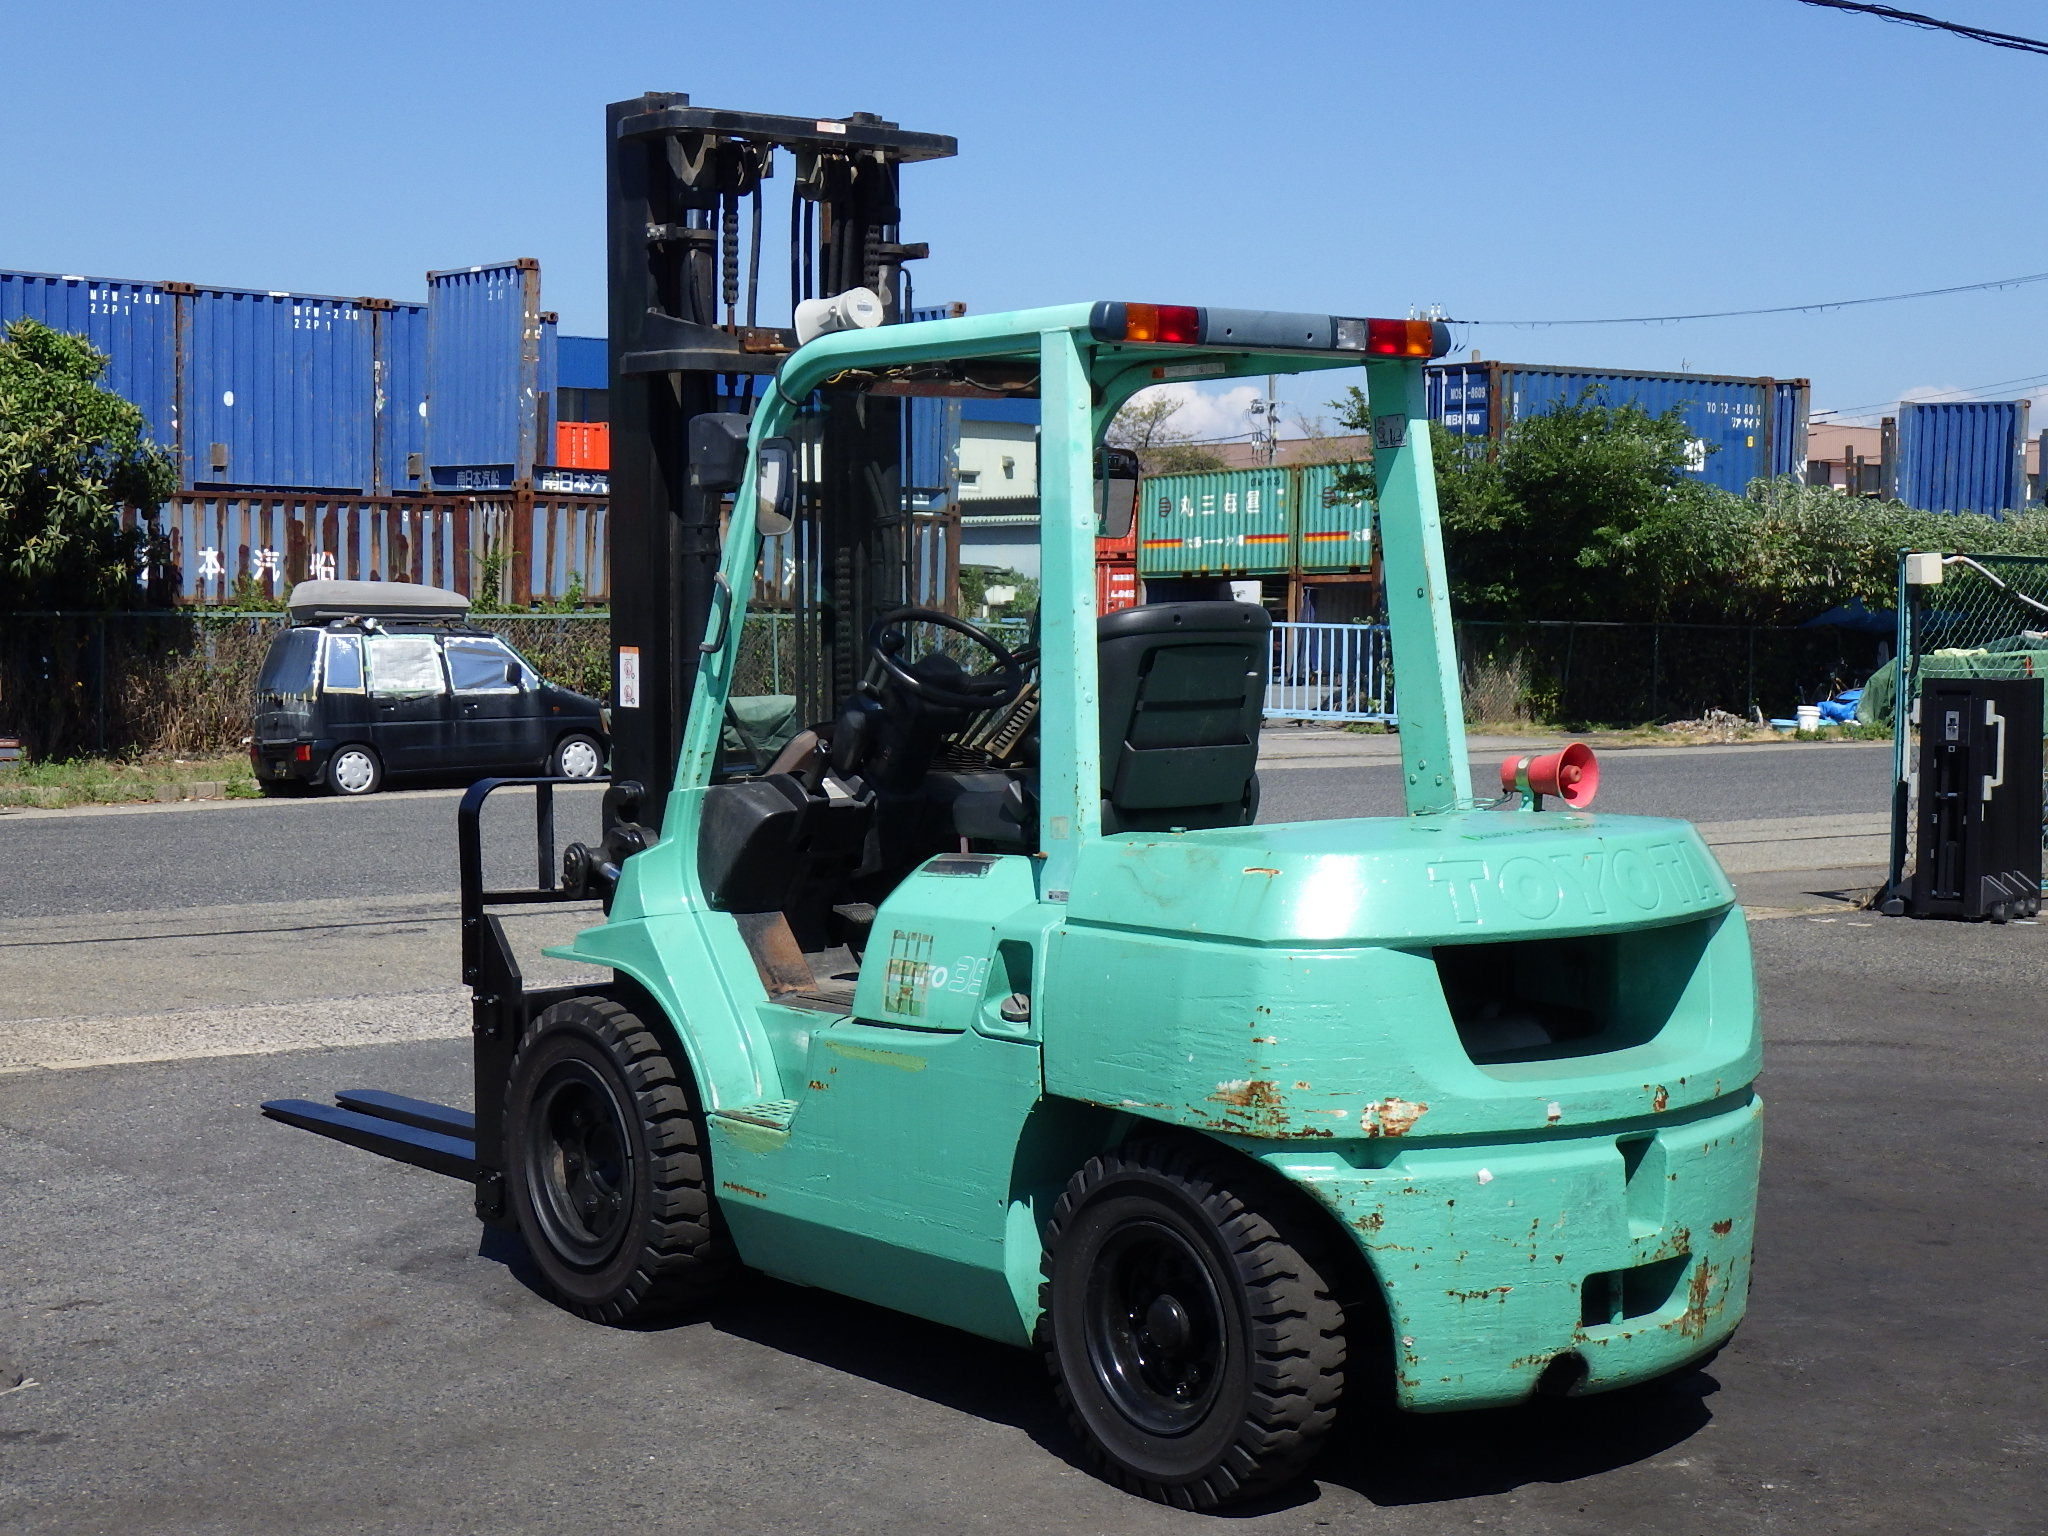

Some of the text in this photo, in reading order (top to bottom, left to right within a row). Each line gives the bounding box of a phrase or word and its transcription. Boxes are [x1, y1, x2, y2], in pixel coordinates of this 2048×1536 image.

[89, 289, 160, 305] MFW-208
[90, 303, 129, 316] 22P1
[294, 305, 359, 321] MFW-220
[294, 318, 331, 331] 22P1
[1450, 386, 1486, 400] MOS-8609
[456, 469, 500, 489] 南日本汽船
[542, 470, 610, 494] 南日本汽
